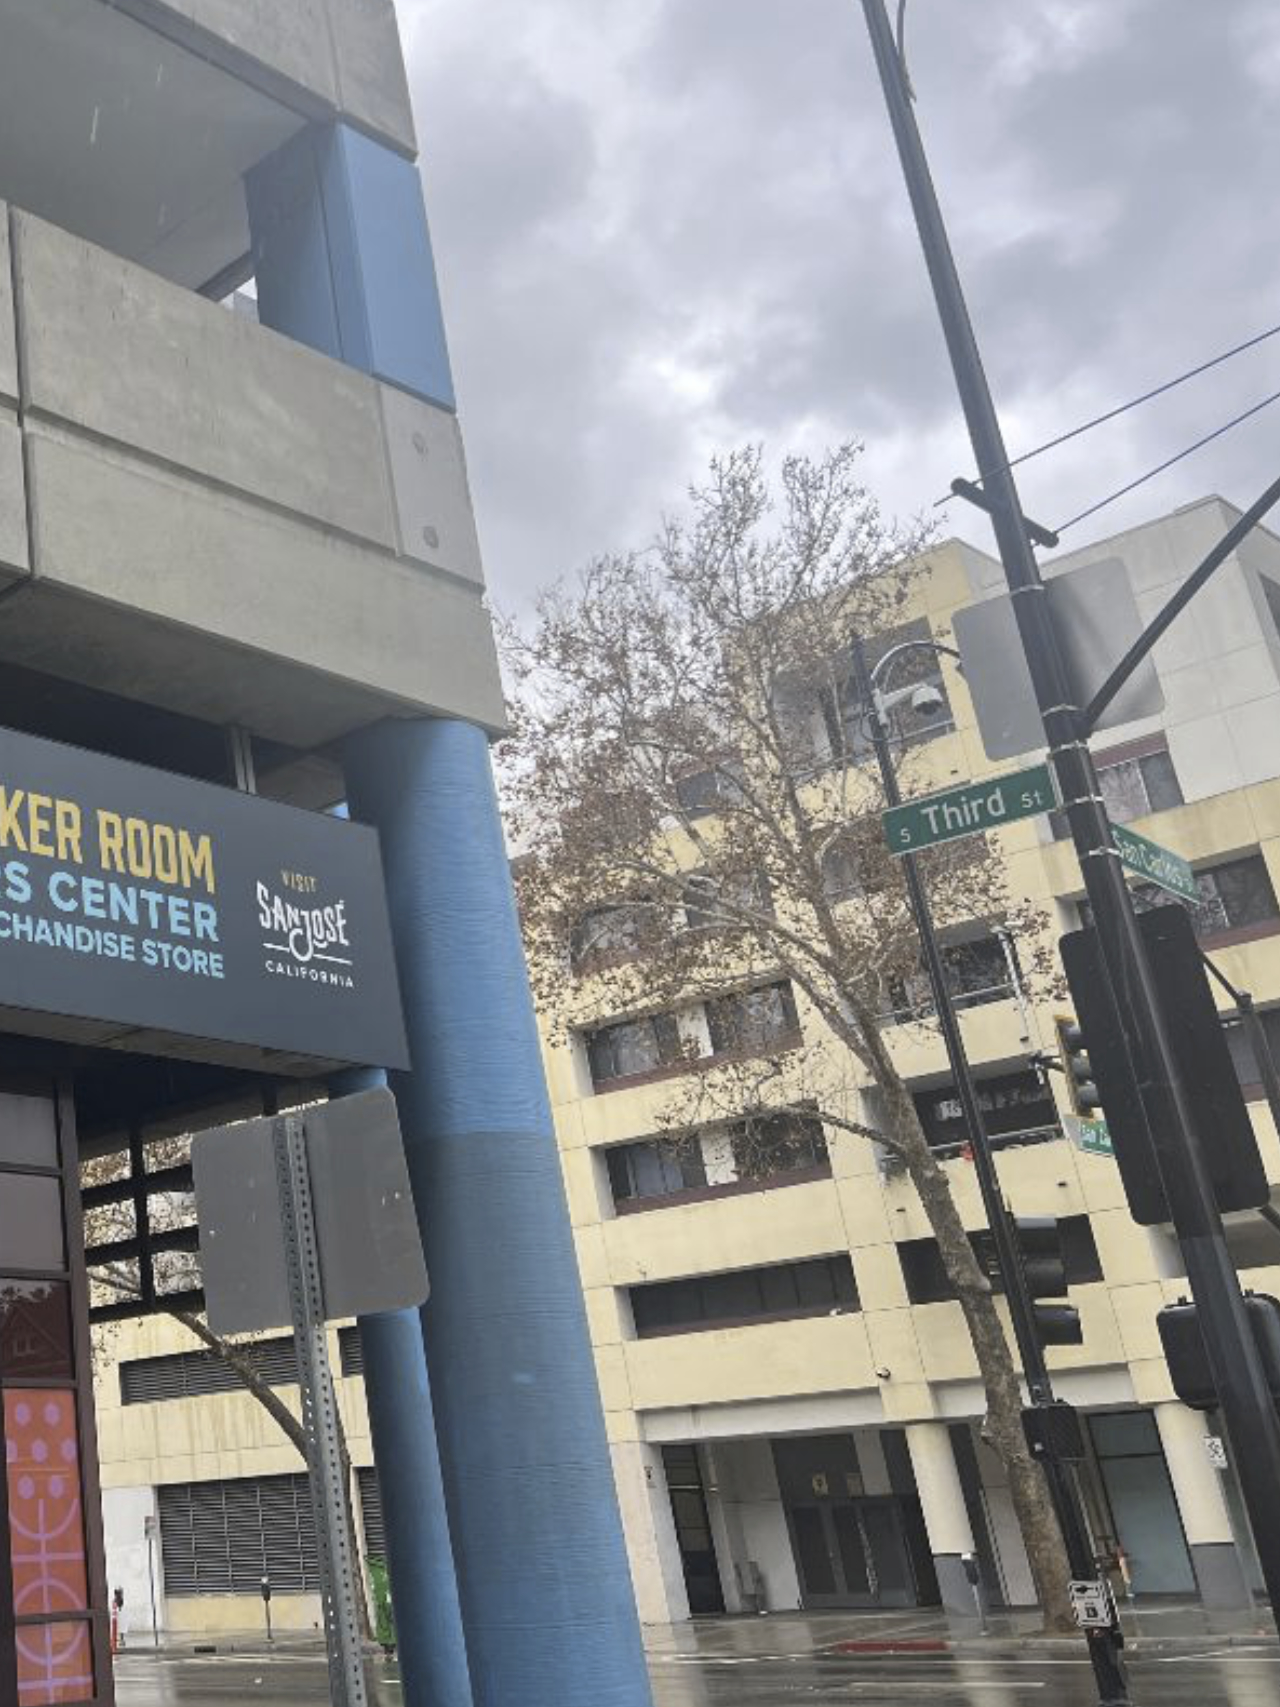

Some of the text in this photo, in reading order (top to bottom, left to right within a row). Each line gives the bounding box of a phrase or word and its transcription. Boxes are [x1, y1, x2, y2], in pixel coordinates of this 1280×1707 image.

[900, 787, 1043, 843] S Third St
[97, 809, 216, 894] ROOM
[280, 869, 318, 893] VISIT
[48, 871, 220, 943] CENTER
[141, 938, 225, 980] STORE
[265, 960, 355, 988] CALIFORNIA
